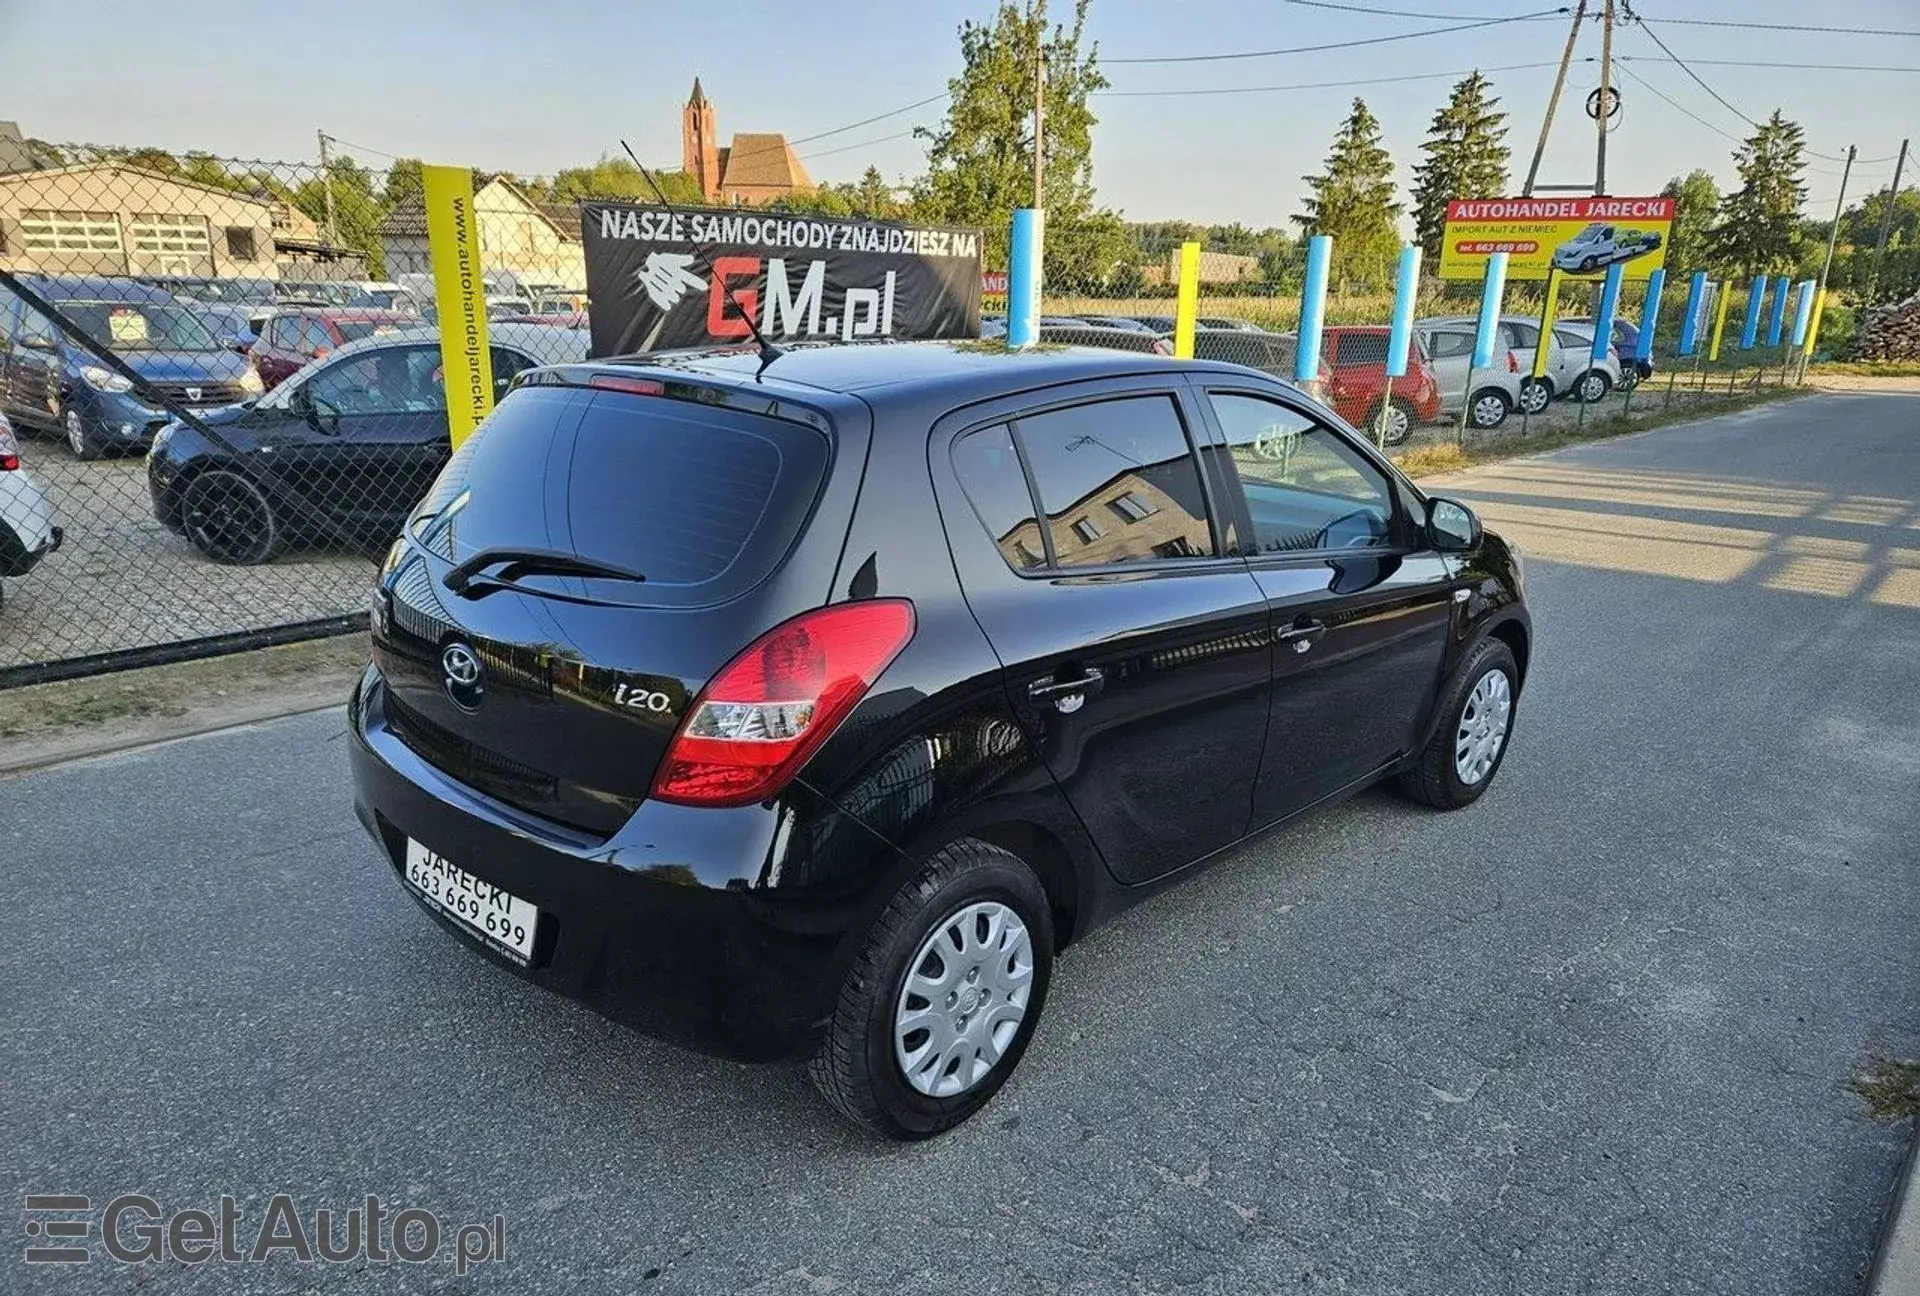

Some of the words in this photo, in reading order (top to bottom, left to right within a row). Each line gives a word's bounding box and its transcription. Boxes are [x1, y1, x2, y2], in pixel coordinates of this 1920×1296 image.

[601, 209, 685, 241] NASZE
[691, 214, 834, 249] SAMOCHODY
[840, 226, 950, 257] ZNAJDZIESZ
[952, 235, 977, 258] NA
[1452, 225, 1488, 233] IMPORT
[1518, 225, 1558, 233] NIEMIEC
[1454, 203, 1580, 218] AUTOHANDEL
[1584, 202, 1666, 217] JARECKI
[707, 255, 895, 341] GM.pl
[411, 864, 440, 895] 663
[446, 888, 479, 919] 669
[486, 912, 525, 945] 699
[423, 850, 512, 914] JARECKI
